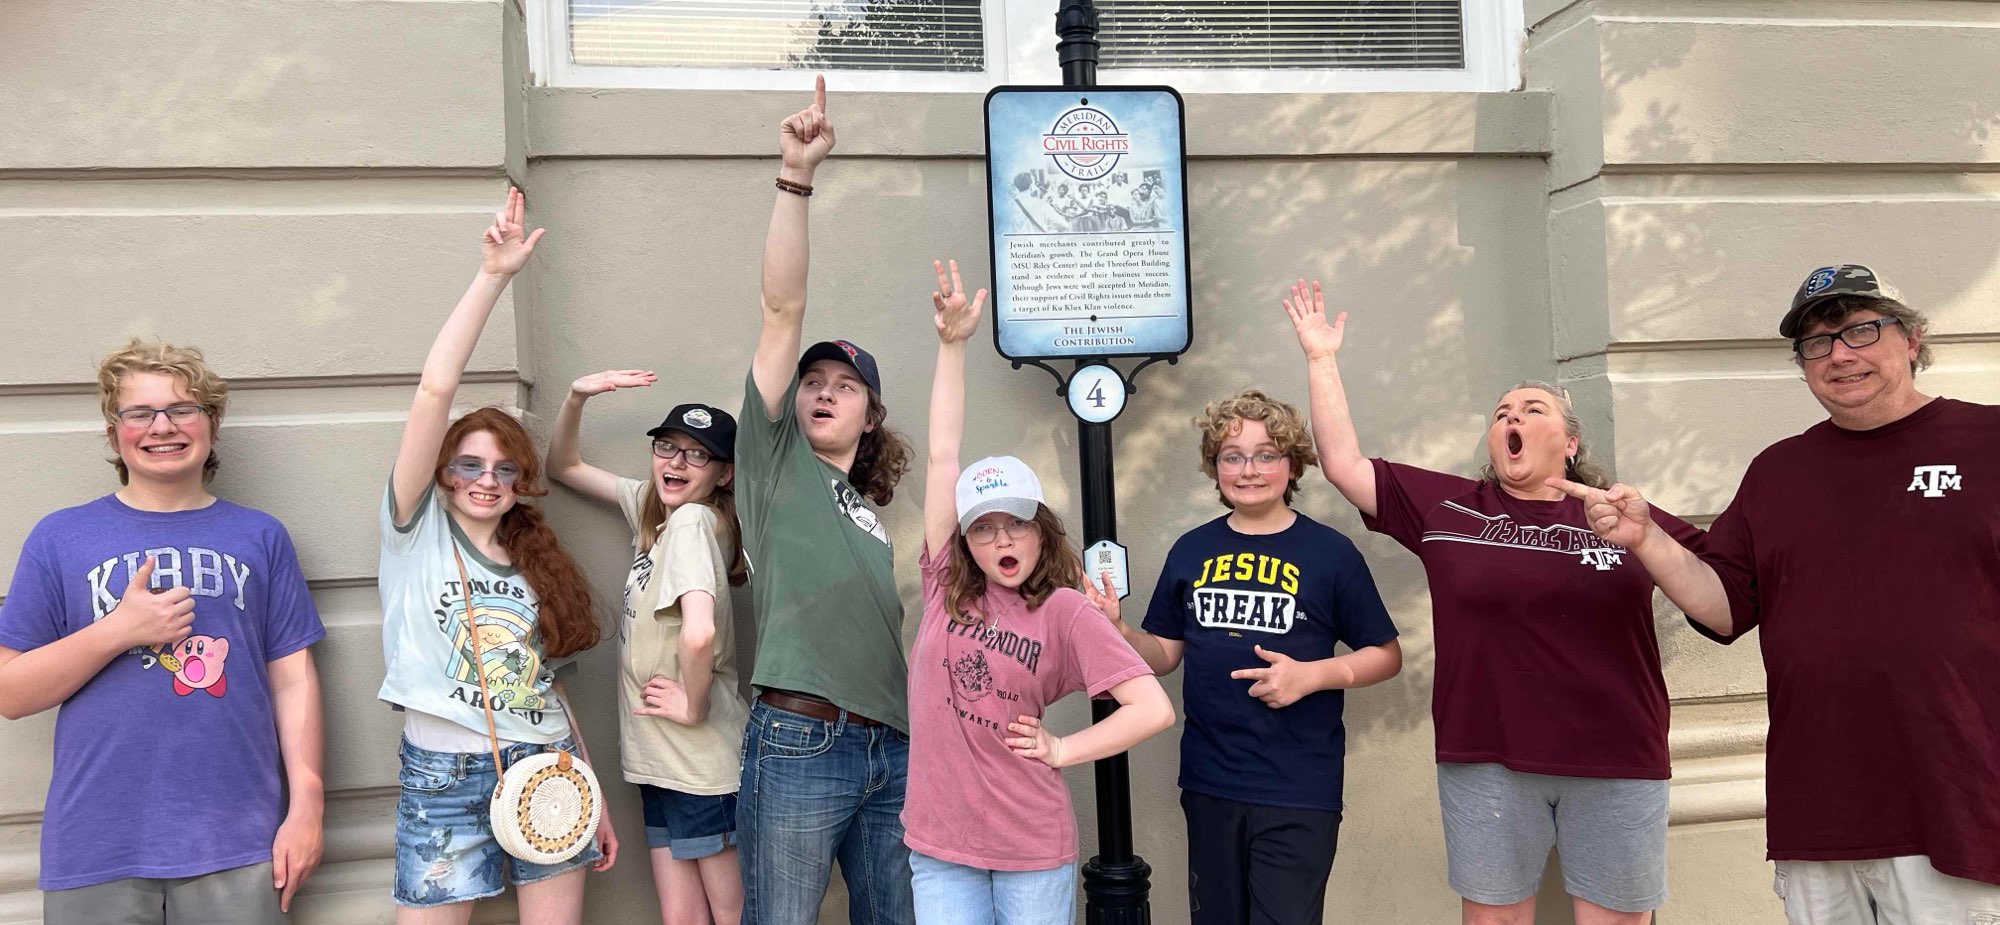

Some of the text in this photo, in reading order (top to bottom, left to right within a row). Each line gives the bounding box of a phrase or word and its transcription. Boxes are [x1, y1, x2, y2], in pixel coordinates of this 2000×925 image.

[1060, 112, 1111, 131] MERIDIAN
[1043, 136, 1129, 151] CIVIL RIGHTS
[1070, 165, 1105, 177] TRAIL
[1083, 239, 1126, 247] contributed
[1131, 239, 1155, 247] greatly
[1050, 251, 1074, 260] growth.
[1123, 250, 1144, 258] Opera
[1142, 260, 1170, 268] Building
[1012, 284, 1043, 292] Although
[1098, 282, 1126, 290] accepted
[1088, 293, 1110, 301] Rights
[1019, 306, 1040, 314] target
[1063, 326, 1123, 335] THE JEWISH
[1054, 337, 1135, 347] CONTRIBUTION
[1086, 378, 1106, 407] 4
[1193, 553, 1300, 595] JESUS
[1198, 592, 1291, 630] FREAK
[449, 686, 543, 725] AROD
